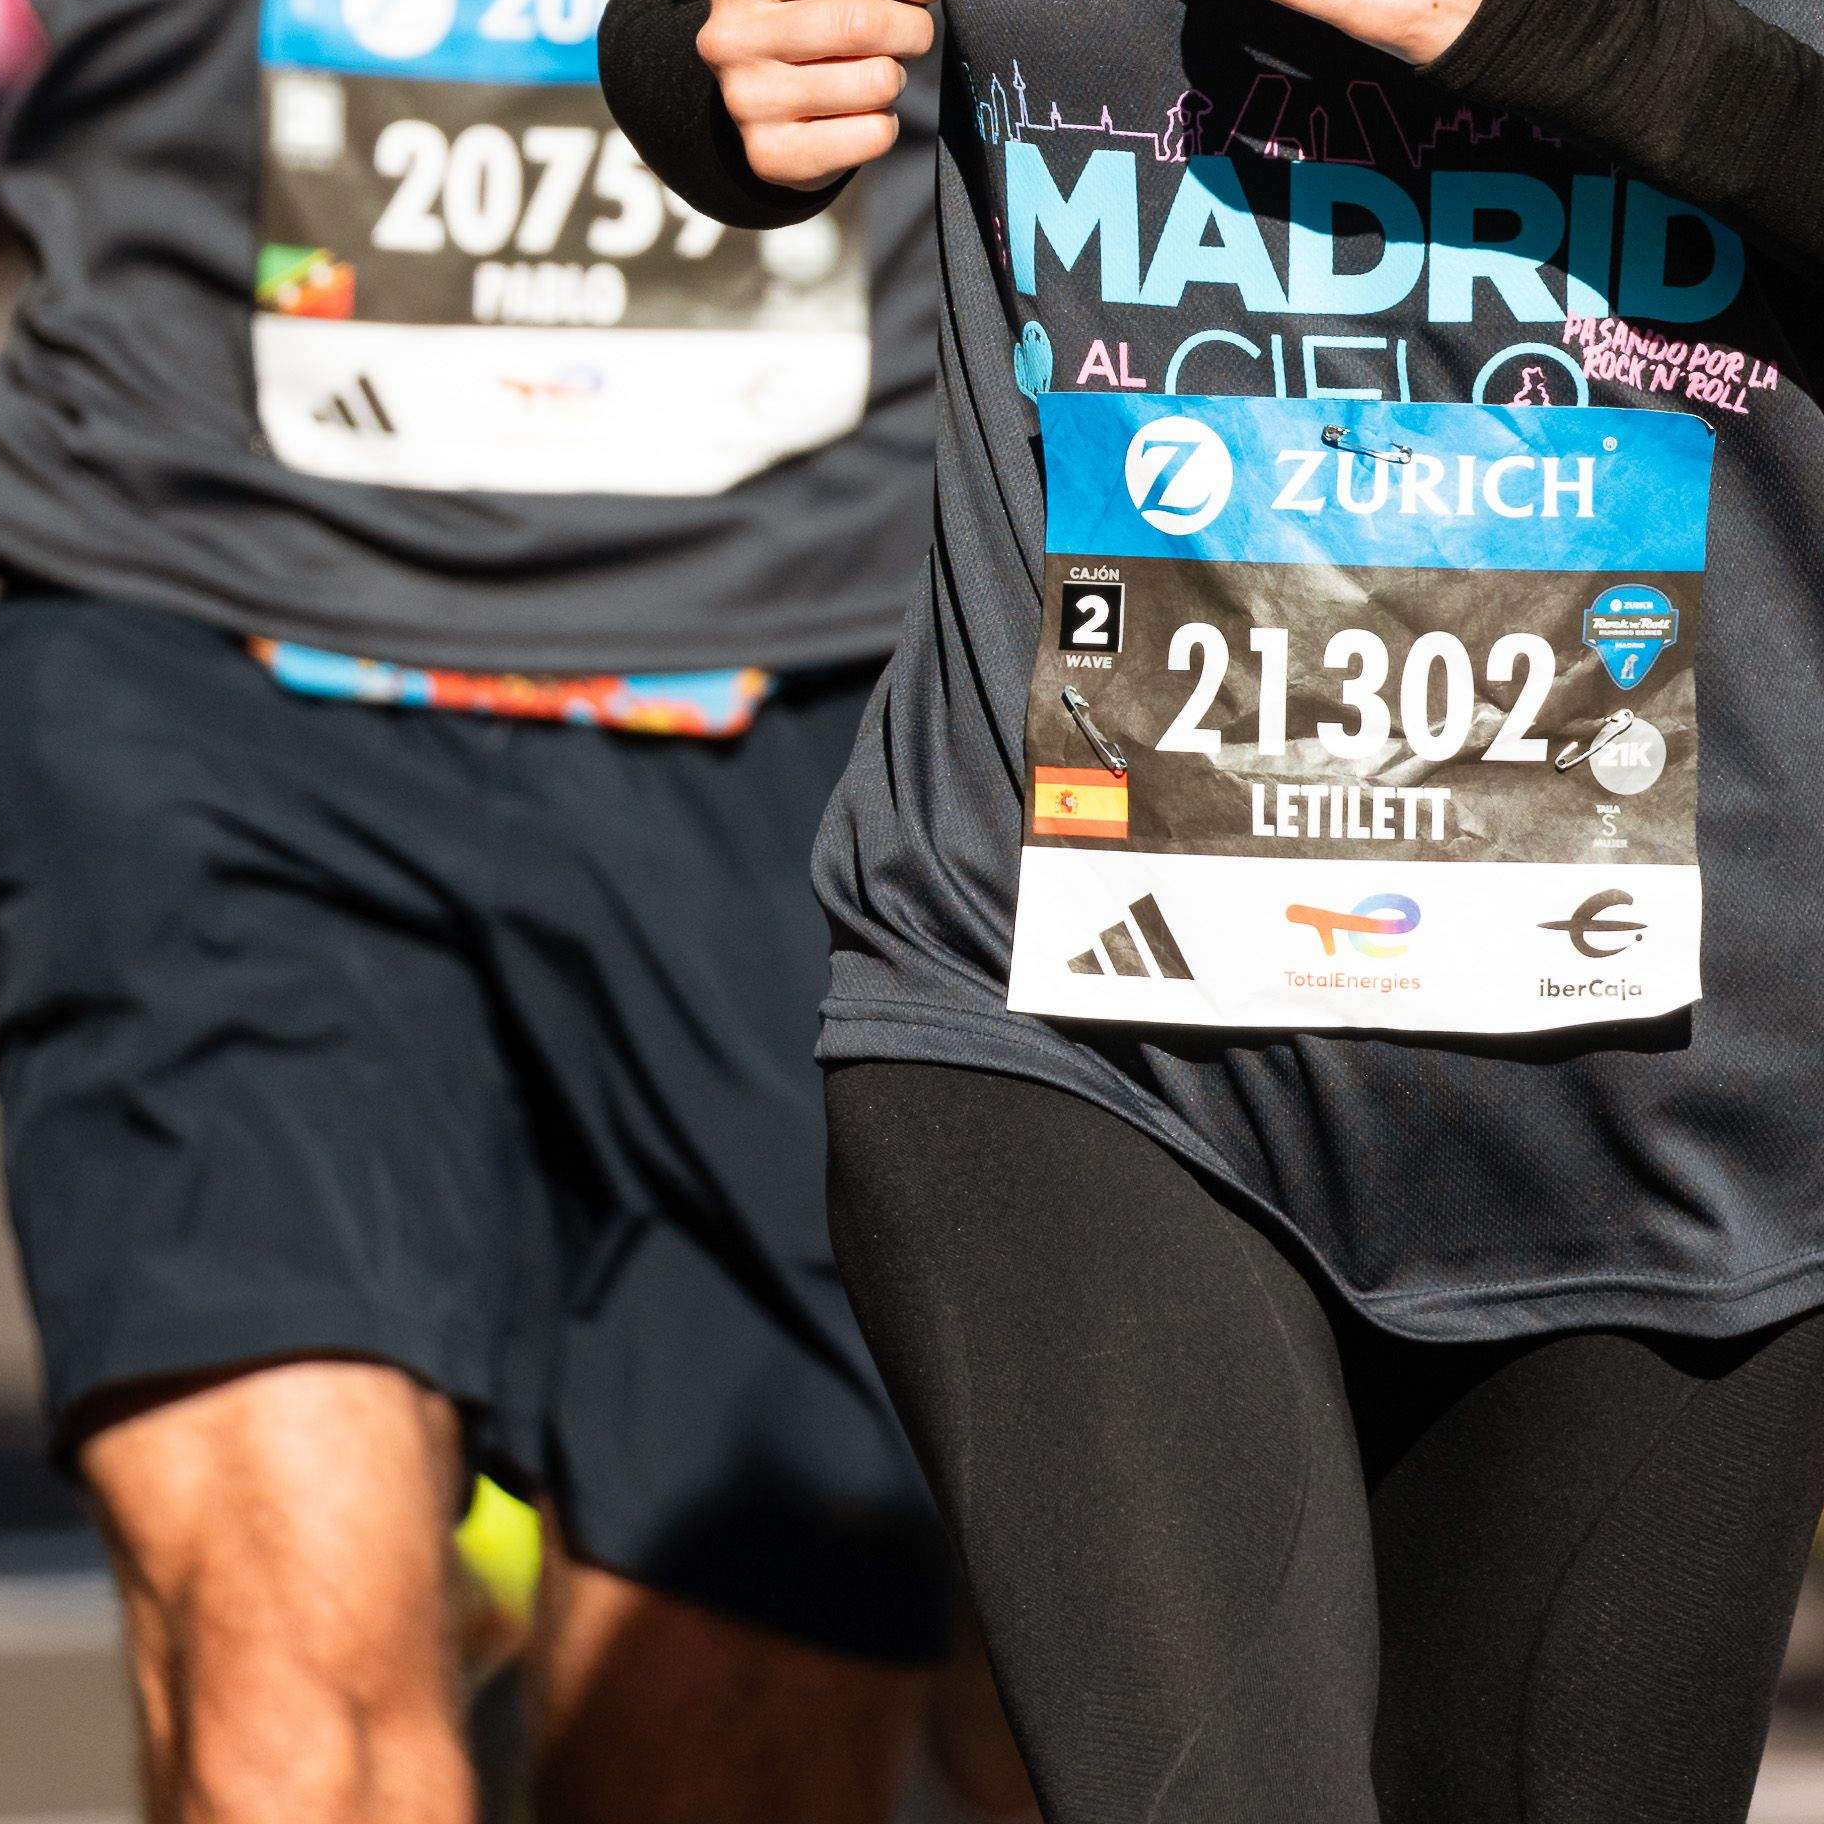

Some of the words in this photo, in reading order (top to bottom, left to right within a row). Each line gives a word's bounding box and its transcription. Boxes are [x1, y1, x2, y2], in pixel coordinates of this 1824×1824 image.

[1005, 142, 1746, 322] MADRID
[1076, 339, 1147, 388] AL
[1562, 310, 1688, 365] PASANDO
[1687, 342, 1745, 384] POR
[1748, 360, 1778, 391] LA
[1583, 344, 1647, 391] ROCK
[1685, 370, 1749, 414] ROLL
[1270, 449, 1596, 518] ZURICH
[1069, 565, 1120, 581] CAJÓN
[1072, 595, 1109, 644] 2
[1066, 655, 1112, 669] WAVE
[1154, 622, 1556, 762] 21302
[1597, 741, 1651, 767] 21K
[1252, 783, 1452, 842] LETILETT
[1284, 971, 1421, 994] TotalEnergies
[1539, 978, 1643, 1002] iberCaja
